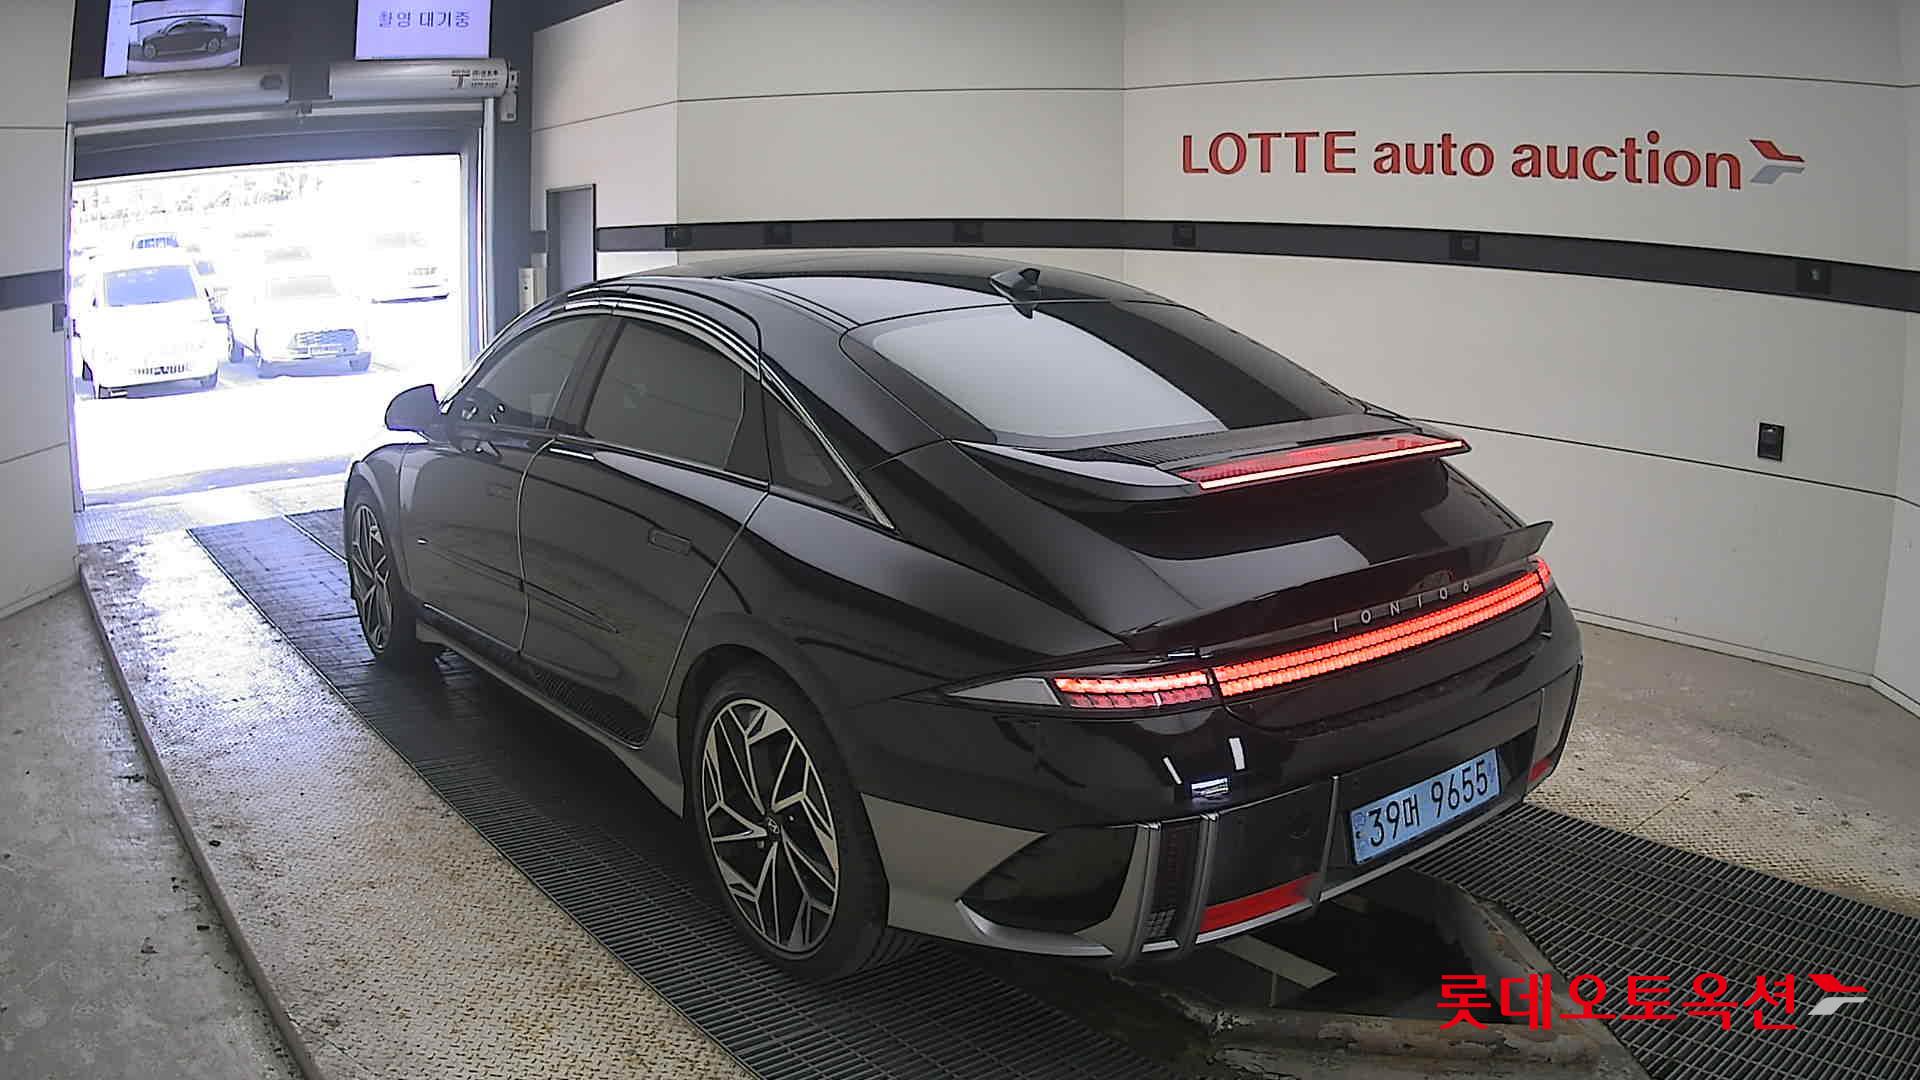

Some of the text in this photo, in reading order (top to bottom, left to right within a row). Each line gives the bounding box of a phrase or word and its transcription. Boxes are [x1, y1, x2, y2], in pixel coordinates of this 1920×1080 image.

[419, 11, 470, 28] 대기중
[1182, 130, 1743, 190] LOTTE auto auction
[1368, 759, 1488, 847] 39머 9655
